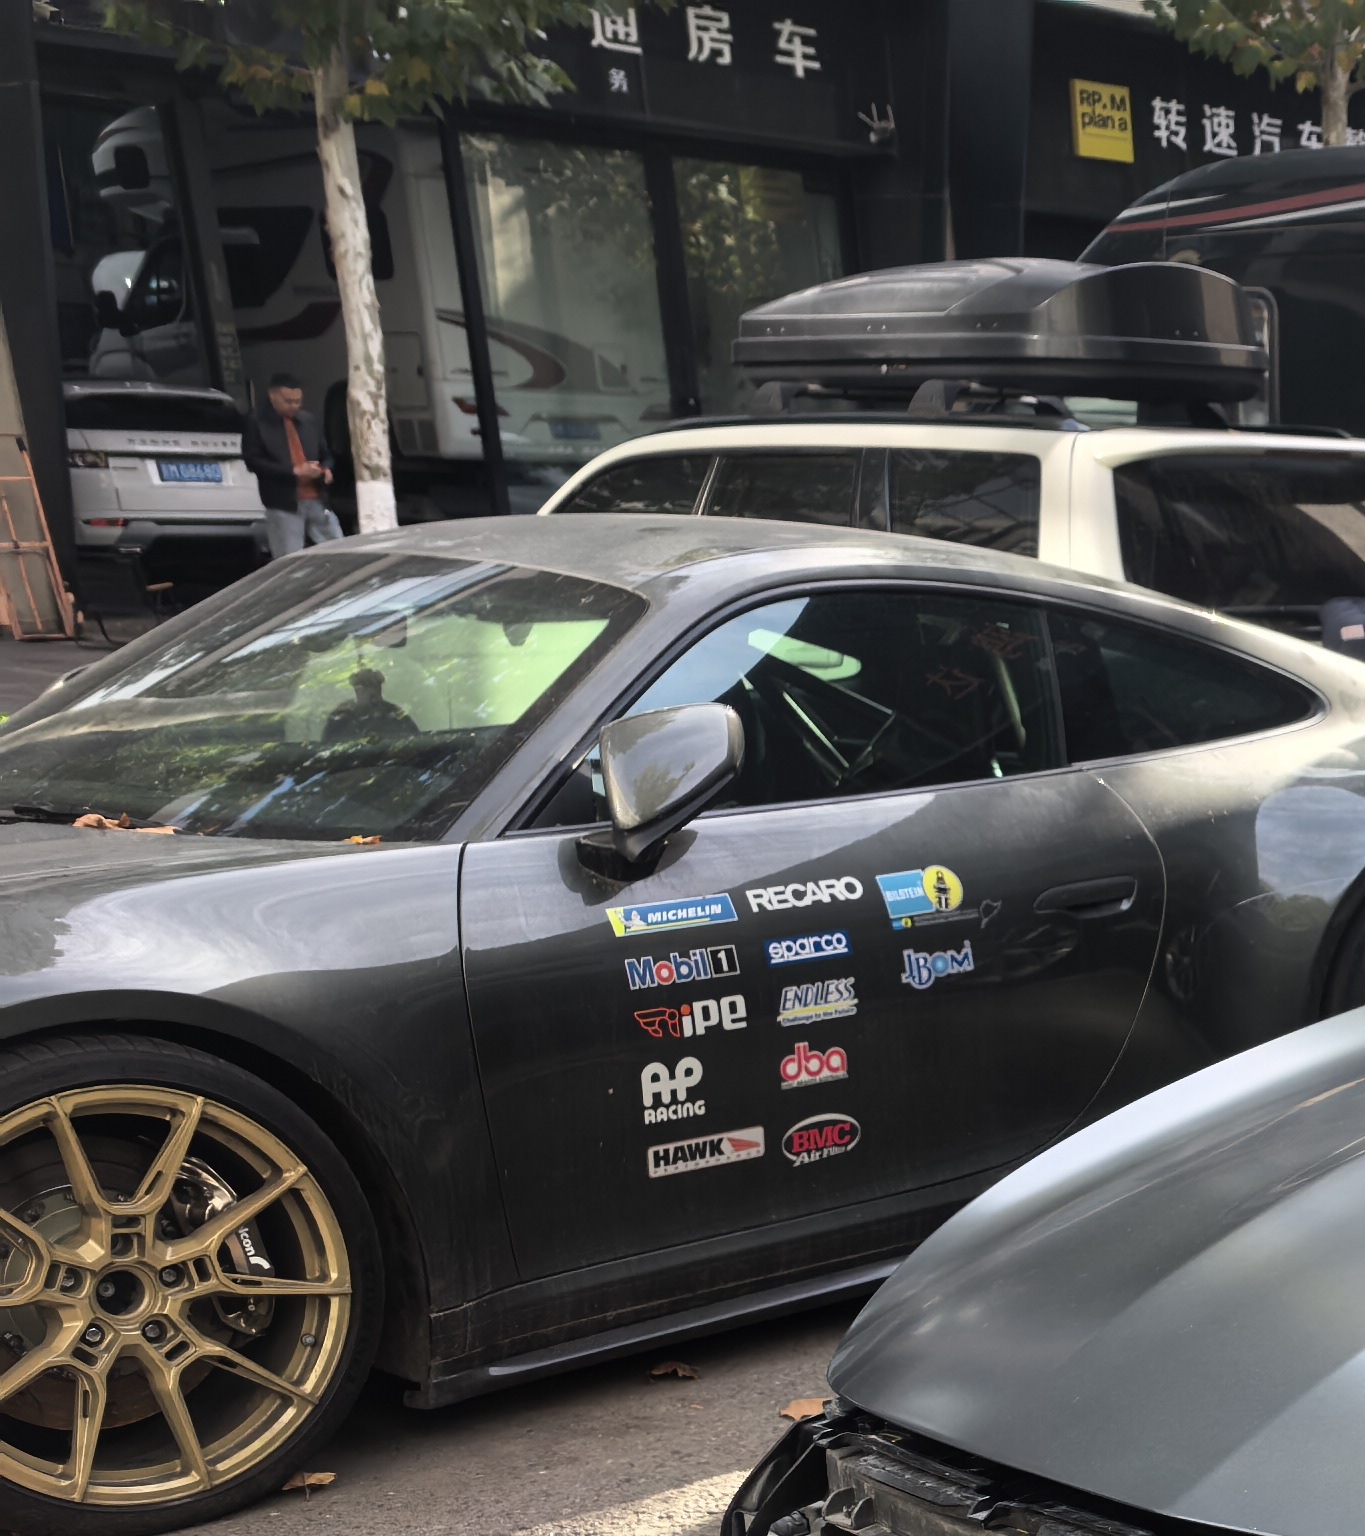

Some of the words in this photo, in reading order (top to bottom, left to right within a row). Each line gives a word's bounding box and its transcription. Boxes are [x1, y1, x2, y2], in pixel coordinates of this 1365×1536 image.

[745, 876, 863, 913] RECARO
[885, 886, 925, 902] BILSTEIN
[647, 903, 722, 923] MICHELIN
[768, 932, 847, 960] sparco
[625, 948, 711, 990] Mobil
[780, 976, 855, 1012] ENDLESS
[781, 1041, 848, 1081] dba
[641, 1056, 703, 1107] AP
[644, 1100, 706, 1125] RACING
[653, 1137, 725, 1169] HAWK
[792, 1122, 852, 1153] BMC
